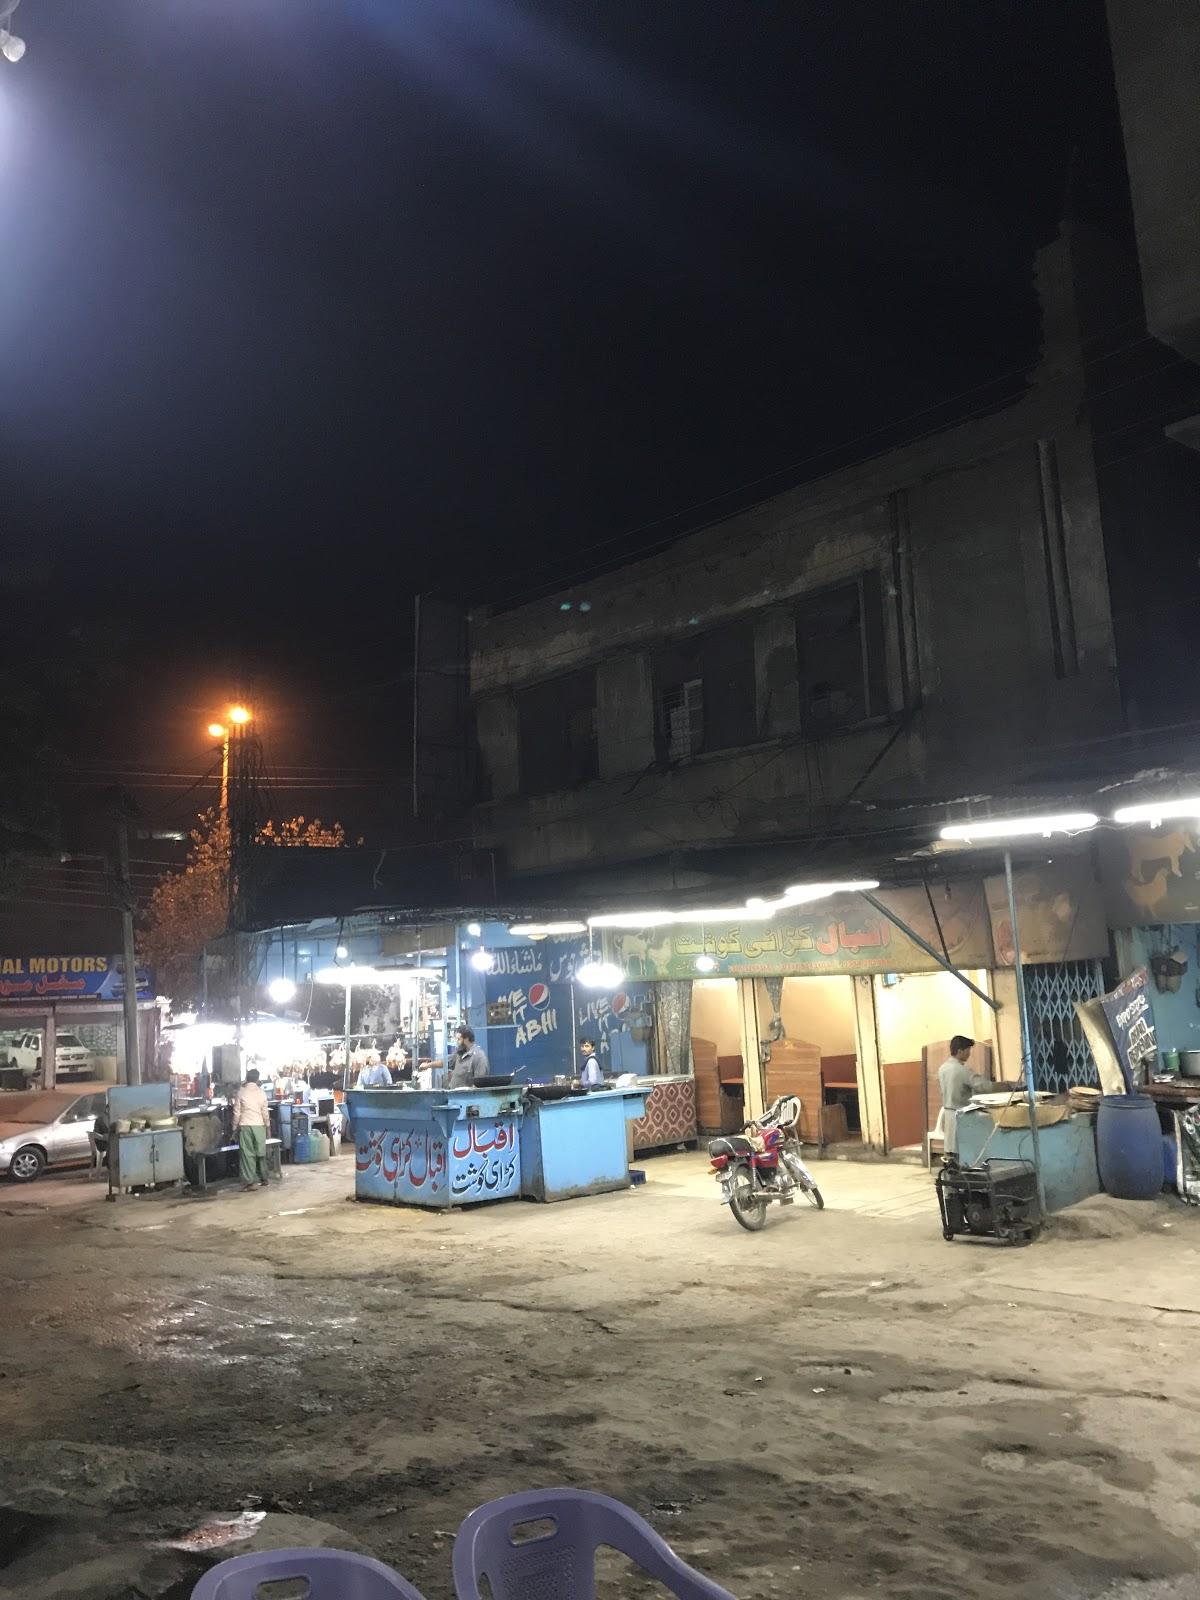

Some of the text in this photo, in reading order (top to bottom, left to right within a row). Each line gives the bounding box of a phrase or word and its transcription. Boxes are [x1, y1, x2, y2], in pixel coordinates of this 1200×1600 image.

[0, 956, 108, 974] AL MOTORS
[513, 1003, 527, 1025] IT
[516, 1008, 557, 1048] ABHI
[453, 1121, 515, 1159] اقبال
[409, 1128, 447, 1193] اقبال
[451, 1159, 489, 1197] گوشت
